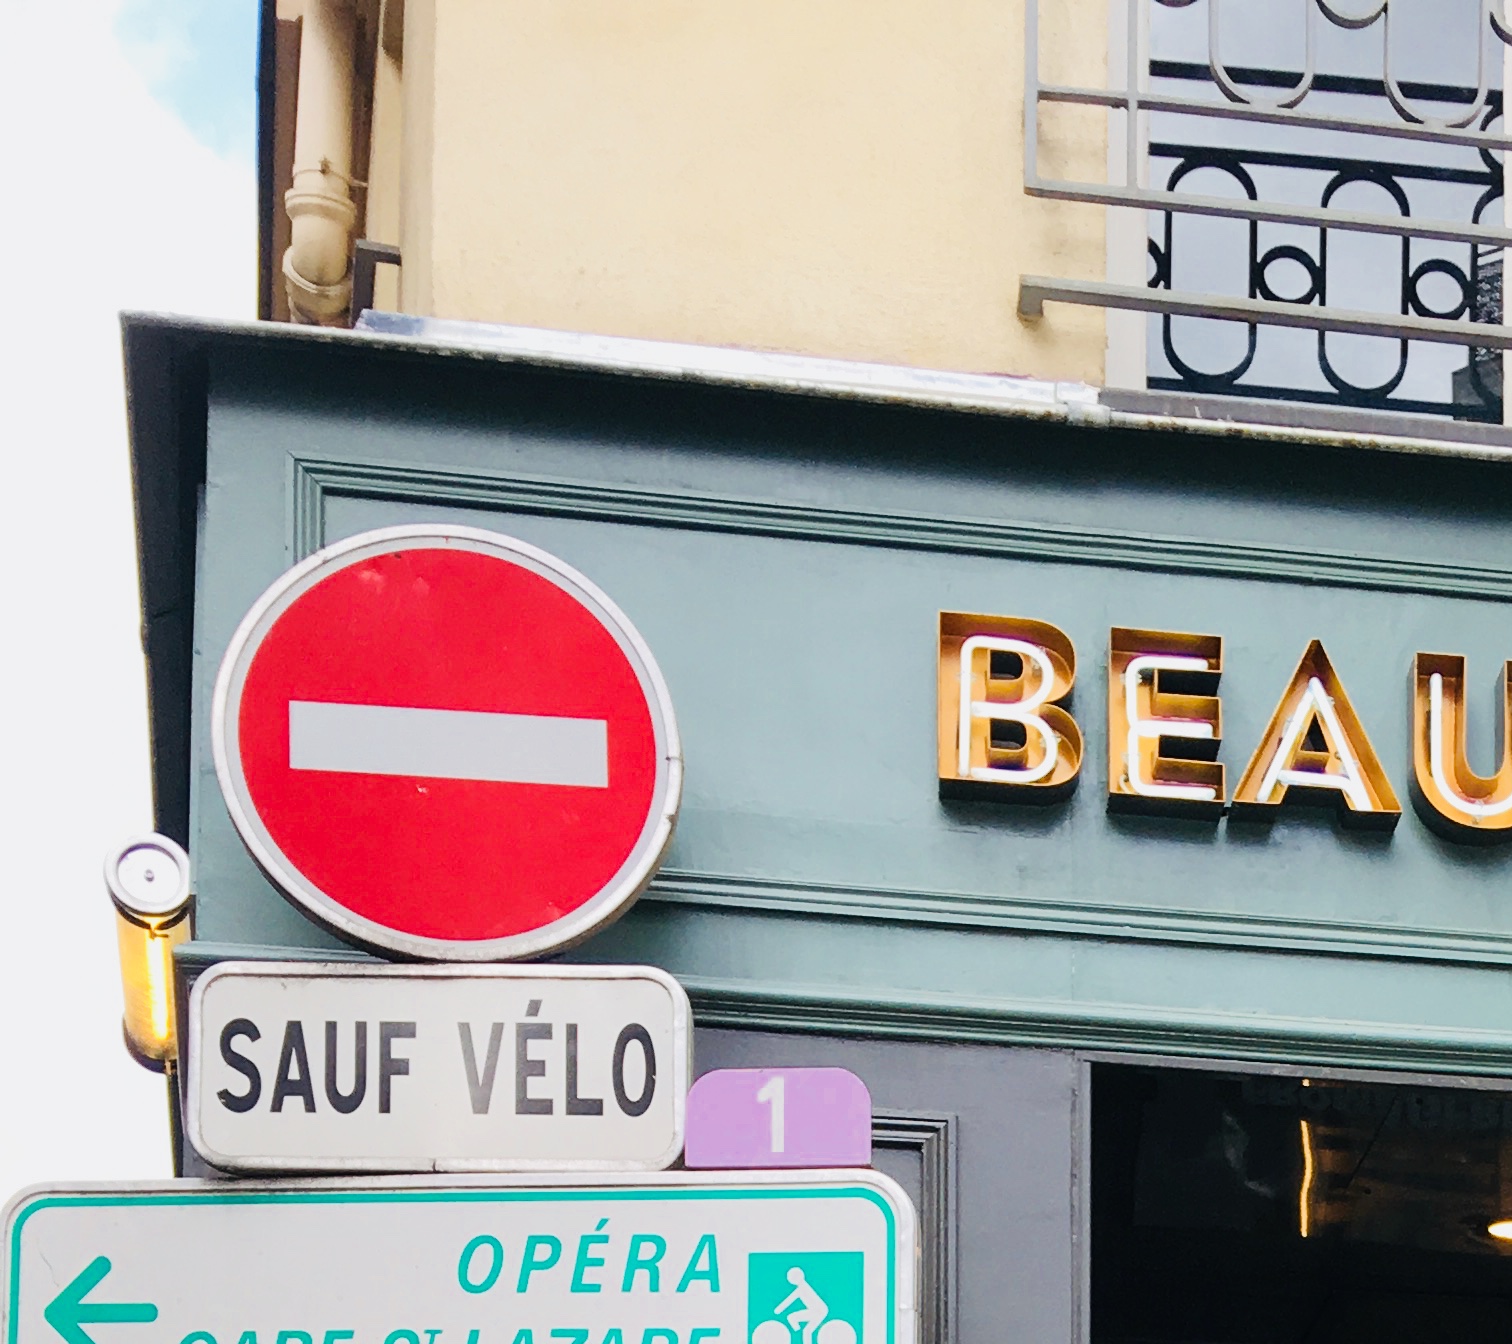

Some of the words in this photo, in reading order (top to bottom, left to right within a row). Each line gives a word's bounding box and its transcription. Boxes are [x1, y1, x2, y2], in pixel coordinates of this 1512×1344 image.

[217, 1019, 417, 1115] SAUF
[457, 1000, 657, 1116] VÉLO
[756, 1075, 785, 1153] 1
[457, 1218, 722, 1294] OPÉRA
